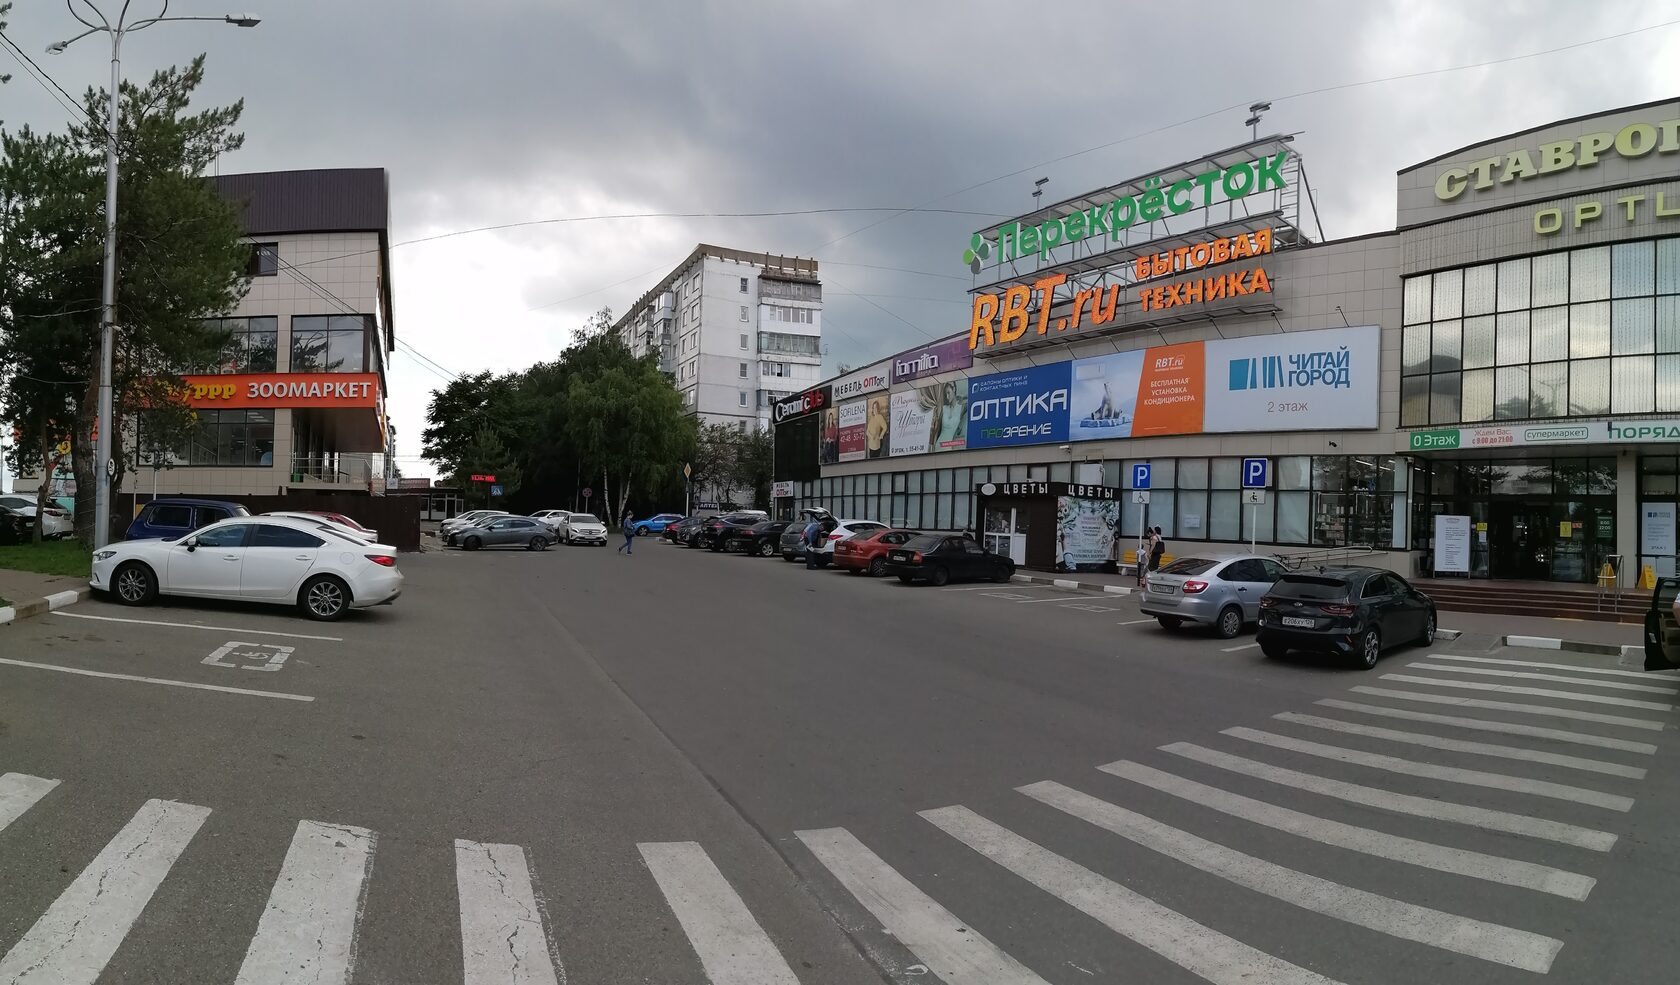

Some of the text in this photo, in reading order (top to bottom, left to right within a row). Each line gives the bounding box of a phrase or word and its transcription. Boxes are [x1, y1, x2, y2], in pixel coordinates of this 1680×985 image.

[998, 150, 1290, 264] Перекрёсток
[1135, 227, 1273, 280] БЫТОВАЯ
[1139, 267, 1272, 312] ТЕХНИКА
[969, 273, 1121, 350] RBT.ru
[1289, 346, 1350, 370] ЧИТАЙ
[1289, 368, 1350, 388] ГОРОД
[247, 382, 371, 398] ЗООМАРКЕТ
[1144, 394, 1195, 405] КОНДИЦИОНЕРА
[1151, 386, 1187, 396] УСТАНОВКА
[970, 388, 1068, 421] ОПТИКА
[1267, 401, 1308, 413] 2 этаж
[1413, 434, 1456, 447] 0 Этаж
[1526, 430, 1585, 439] супермаркет
[1137, 467, 1148, 487] P
[1250, 462, 1263, 484] P
[1003, 484, 1048, 495] ЦВЕТЫ
[1068, 484, 1113, 498] ЦВЕТЫ
